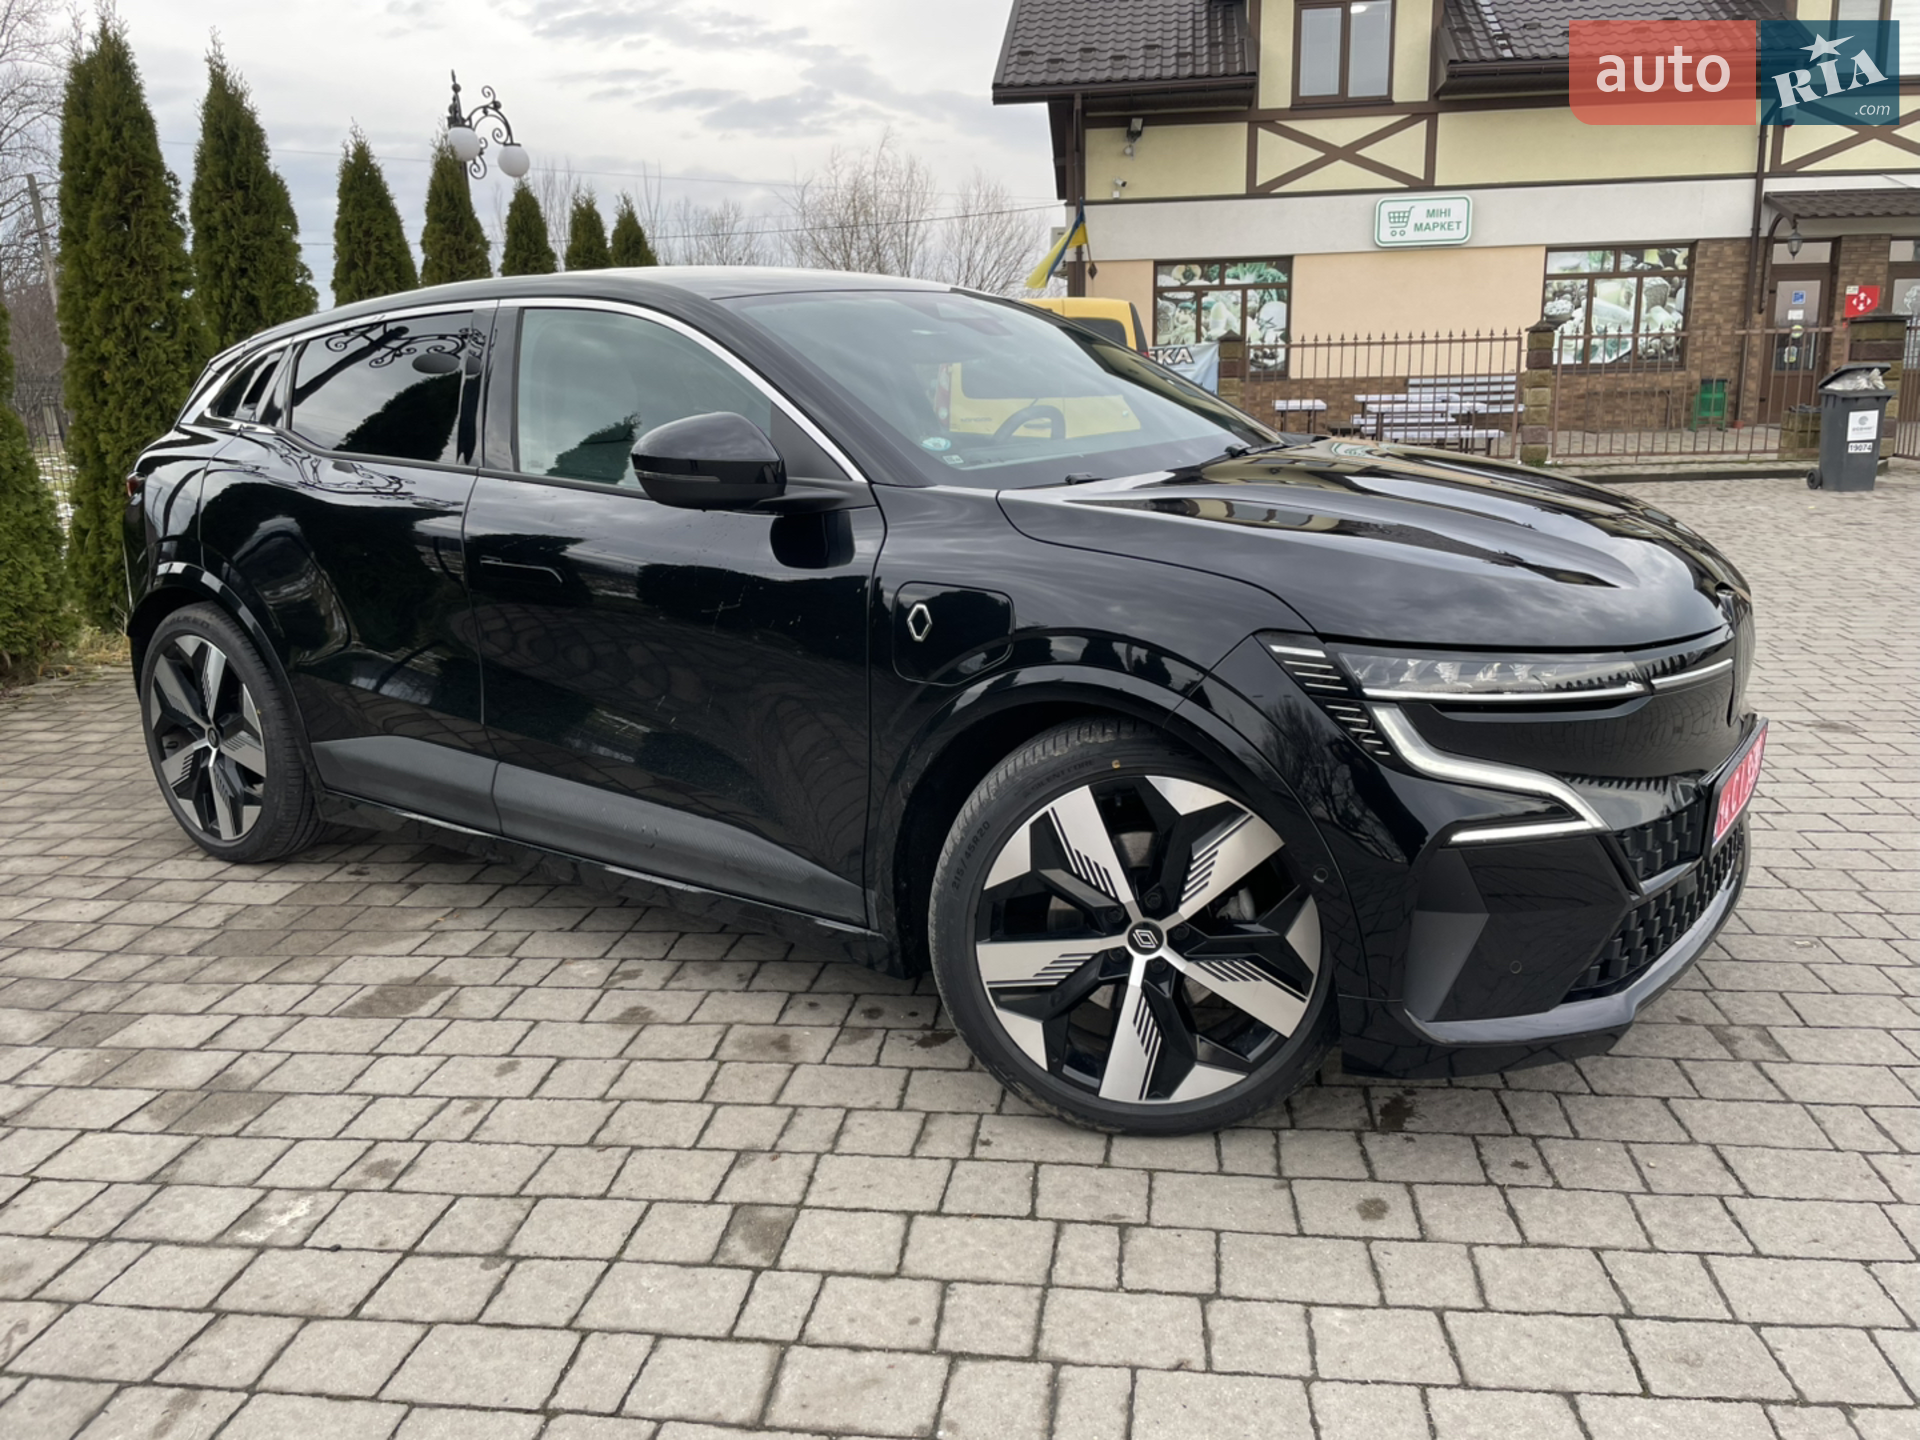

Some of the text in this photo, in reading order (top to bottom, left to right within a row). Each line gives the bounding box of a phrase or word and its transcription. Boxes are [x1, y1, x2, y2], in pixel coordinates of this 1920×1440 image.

[1426, 208, 1451, 218] МІНІ
[1413, 221, 1462, 232] МАРКЕТ
[951, 820, 991, 891] 215/45R20
